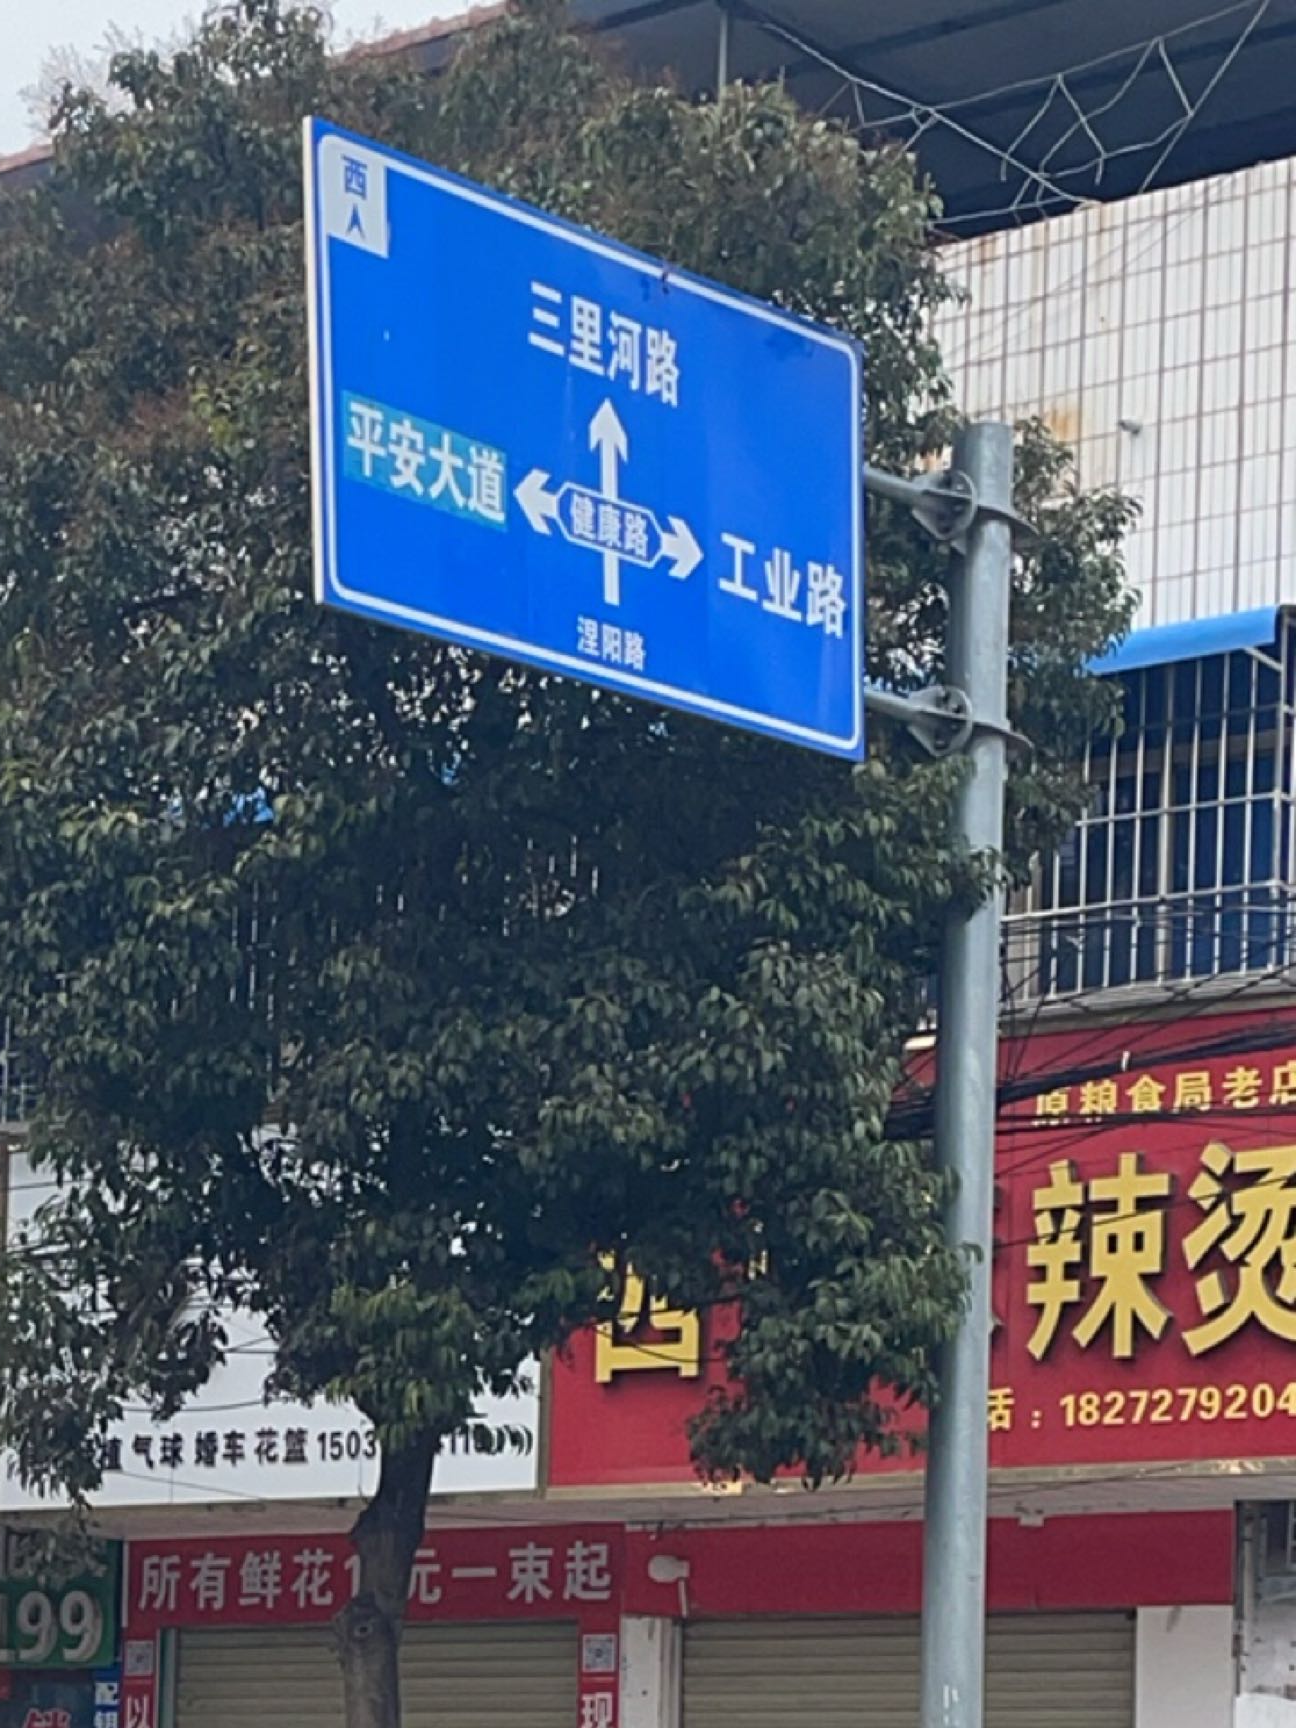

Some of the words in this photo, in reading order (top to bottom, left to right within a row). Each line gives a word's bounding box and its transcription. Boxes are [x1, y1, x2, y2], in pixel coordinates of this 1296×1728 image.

[340, 152, 368, 200] 西
[528, 280, 681, 408] 三里河路
[346, 400, 506, 523] 平安大道
[718, 531, 846, 639] 工业路
[138, 1540, 612, 1612] 所有鲜花1元一束起
